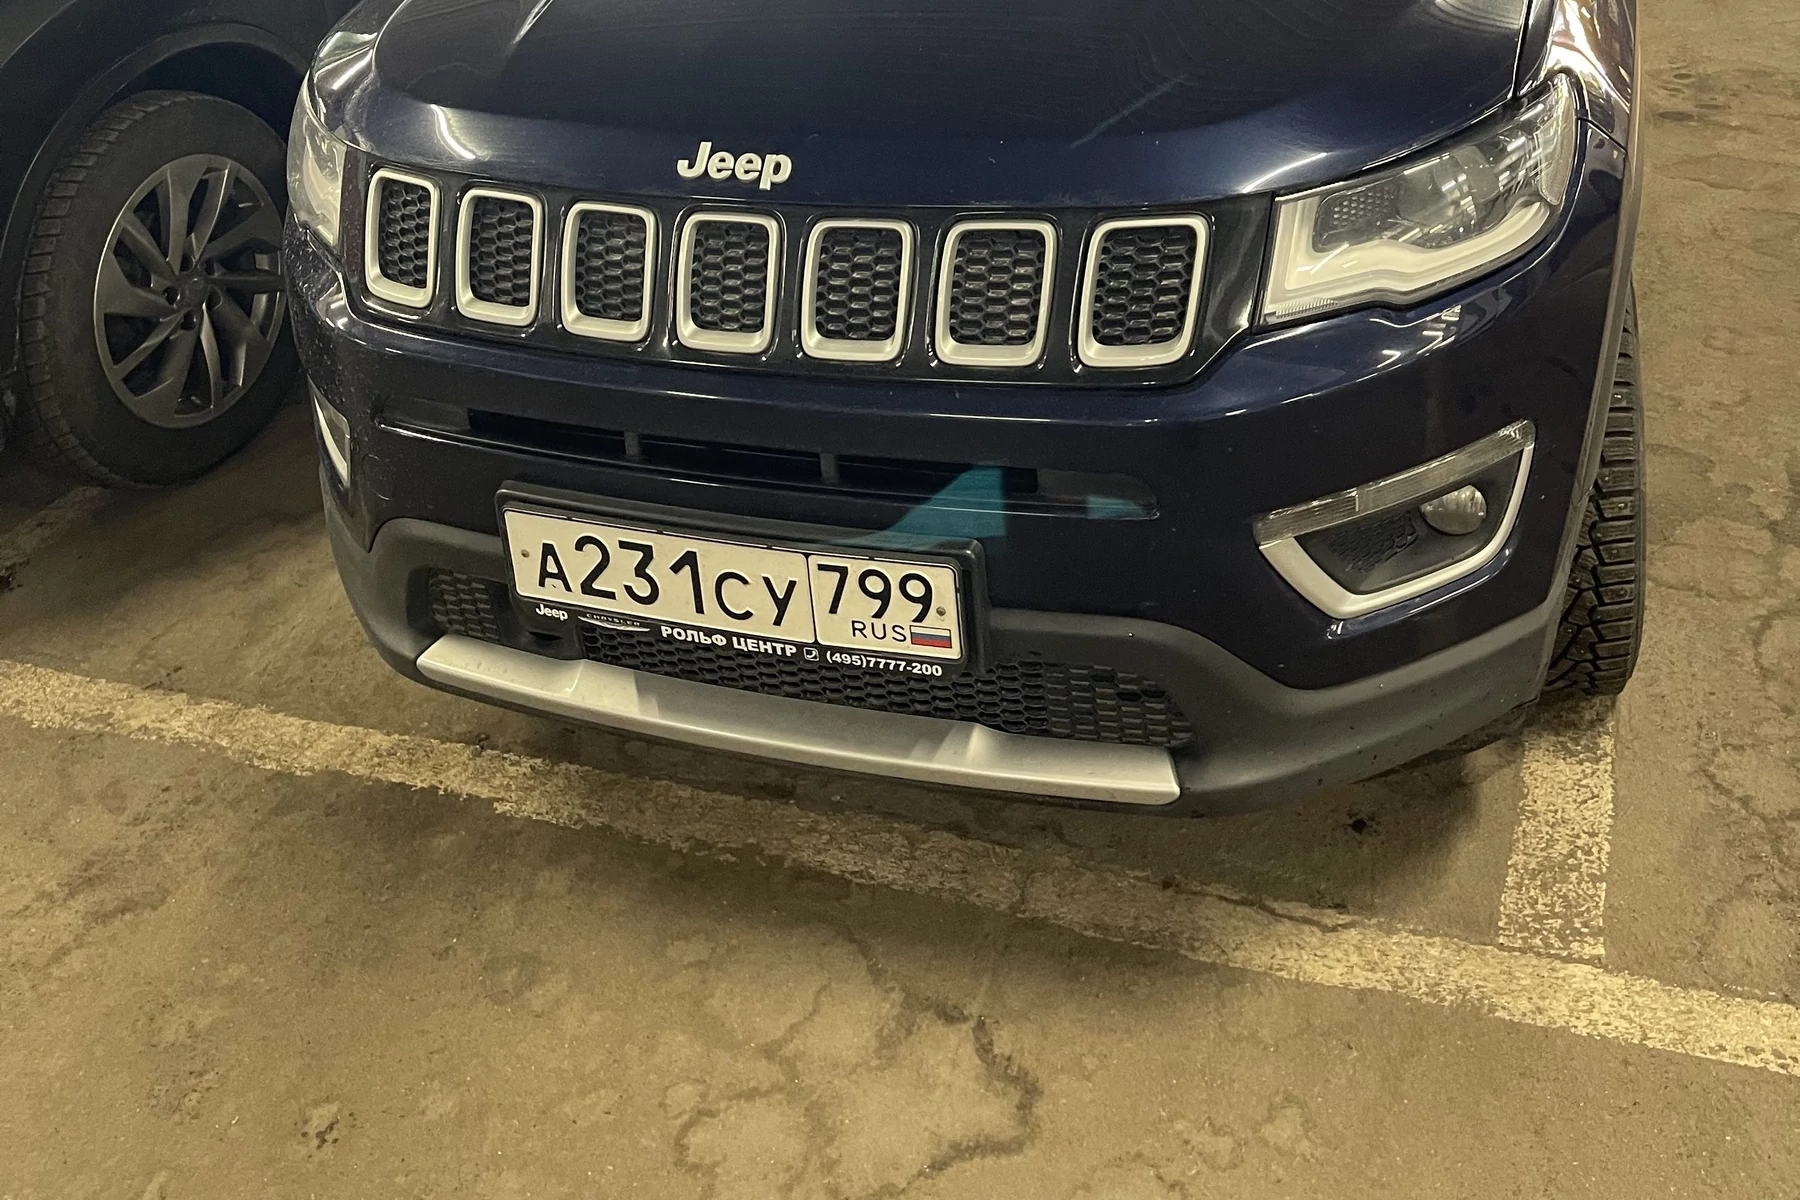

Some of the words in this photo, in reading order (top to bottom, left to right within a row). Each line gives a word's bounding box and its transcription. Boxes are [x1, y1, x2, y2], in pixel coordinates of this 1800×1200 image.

[676, 141, 792, 190] Jeep
[539, 536, 797, 627] А231СУ
[816, 564, 934, 624] 799
[535, 603, 569, 622] Jeep
[851, 621, 907, 643] RUS
[661, 626, 727, 647] РОЛЬФ
[732, 637, 797, 657] ЦЕНТР
[825, 650, 943, 677] (495)7777-200
